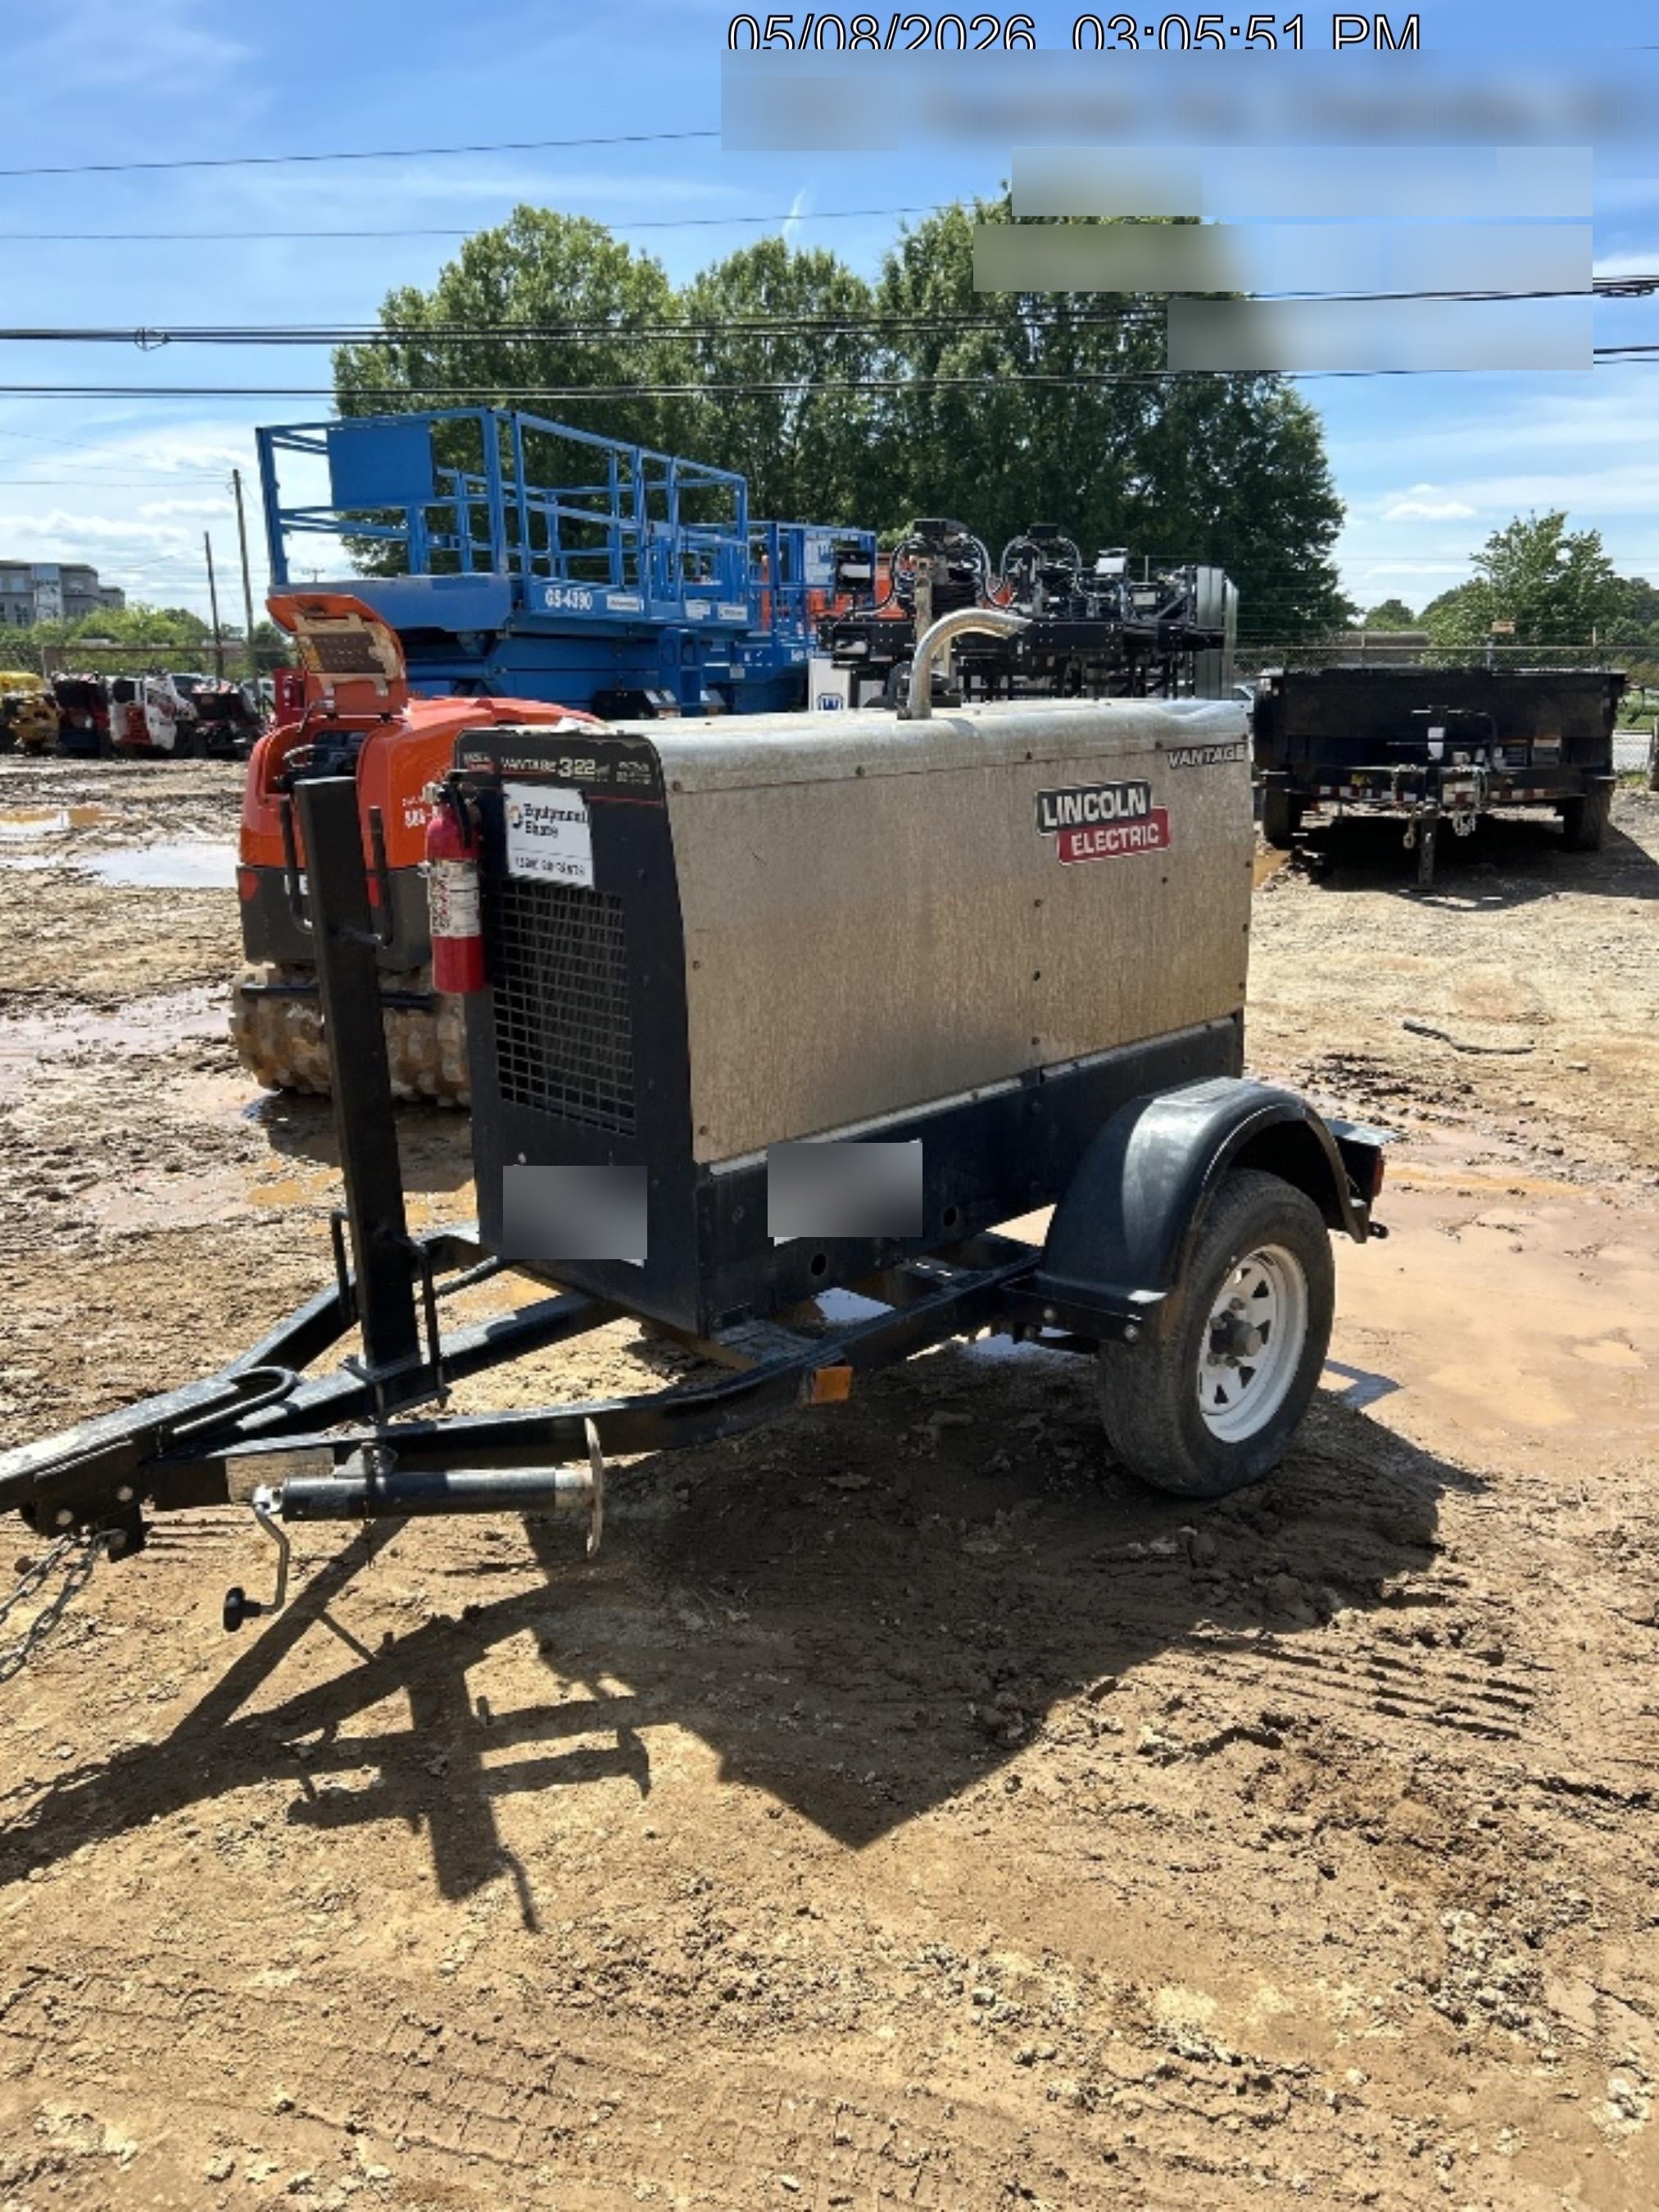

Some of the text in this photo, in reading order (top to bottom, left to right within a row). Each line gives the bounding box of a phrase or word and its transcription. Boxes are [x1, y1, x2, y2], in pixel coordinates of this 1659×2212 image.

[559, 757, 596, 777] 322
[1168, 745, 1245, 768] VANTAGE
[1042, 786, 1146, 827] LINCOLN
[1071, 823, 1159, 856] ELECTRIC
